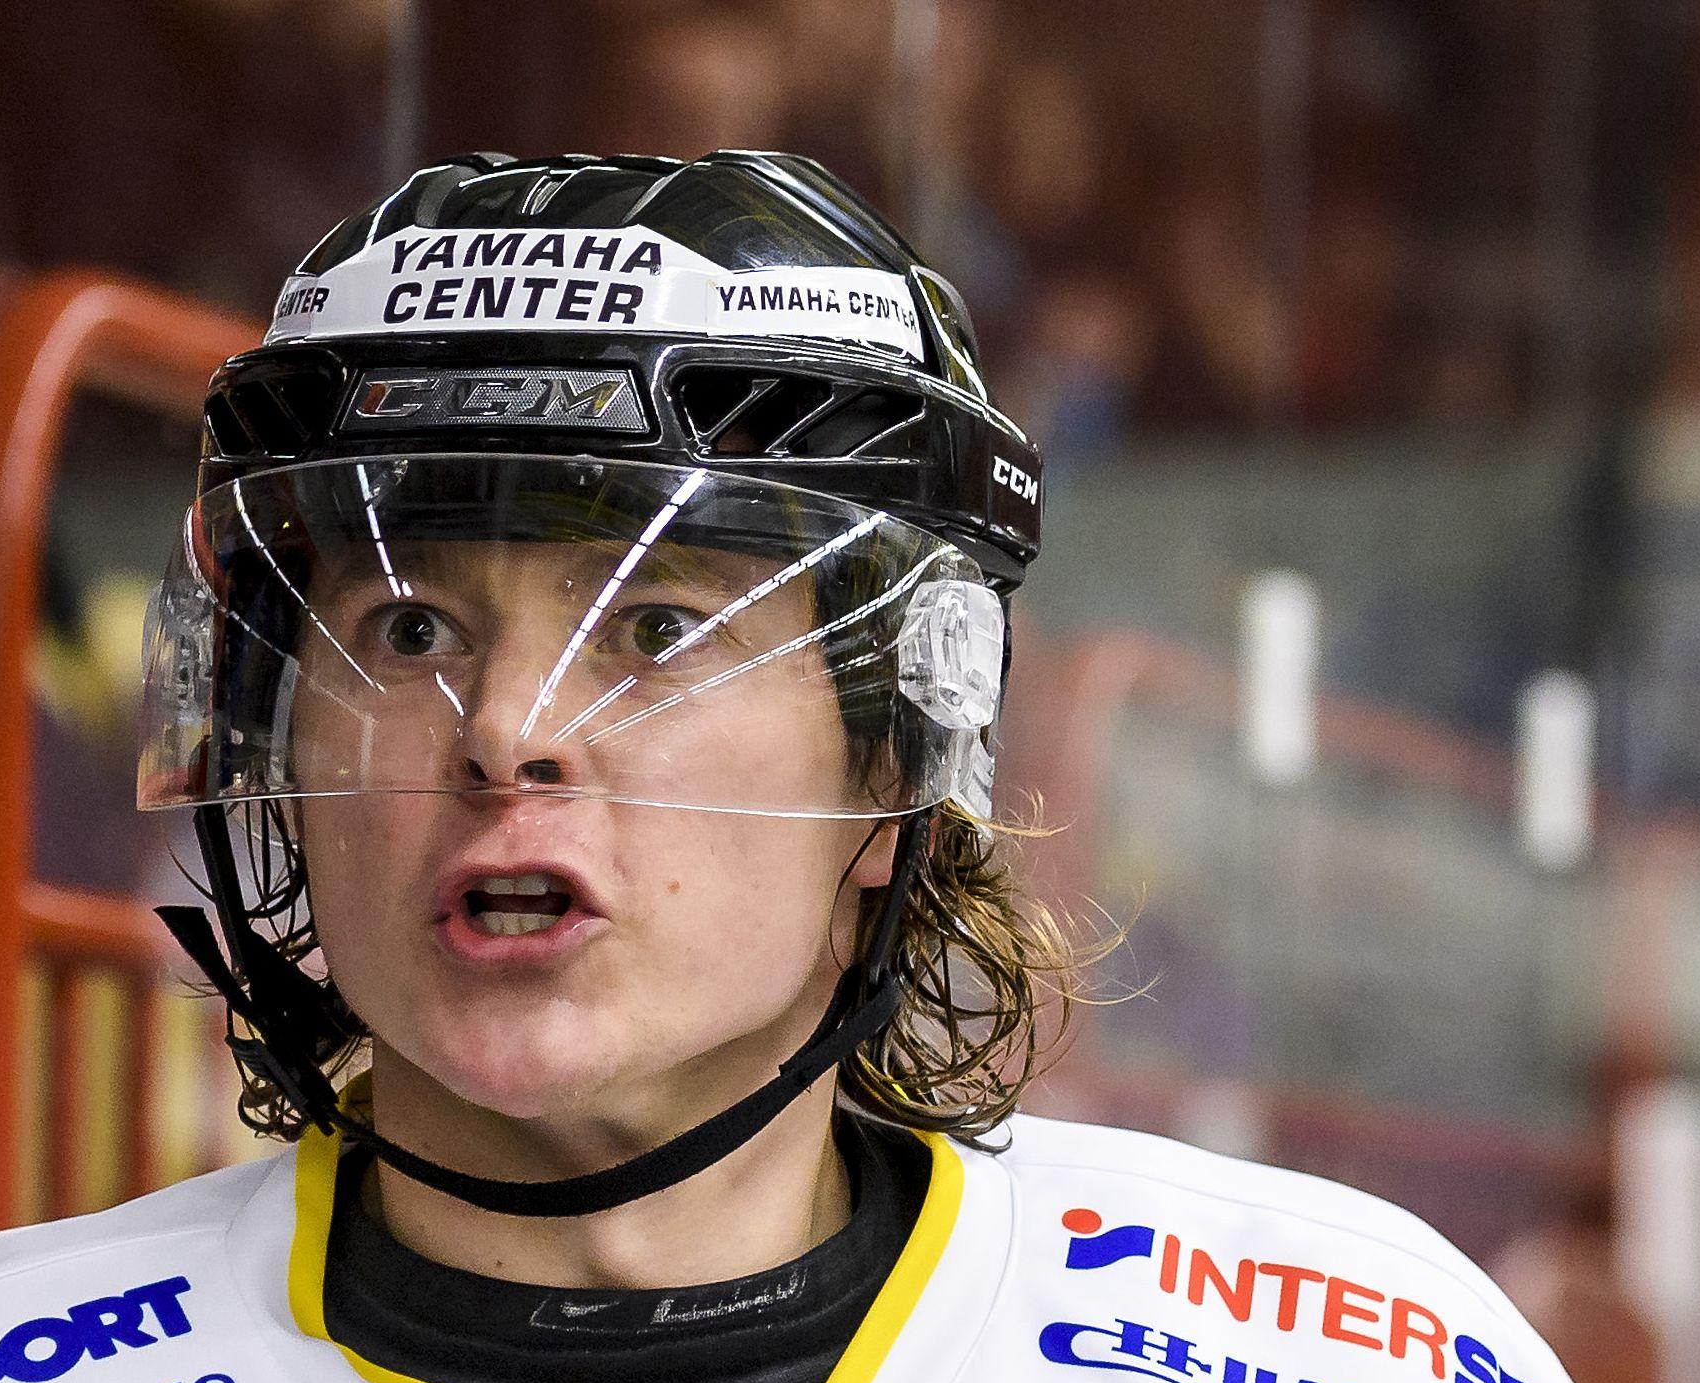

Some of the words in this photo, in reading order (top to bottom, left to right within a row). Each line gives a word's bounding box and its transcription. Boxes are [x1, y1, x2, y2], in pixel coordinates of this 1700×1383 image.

[390, 232, 663, 276] YAMAHA
[277, 286, 330, 317] ENTER
[382, 276, 645, 325] CENTER
[716, 285, 841, 313] YAMAHA
[848, 290, 919, 334] CENTER
[356, 378, 628, 420] CCM
[992, 454, 1039, 506] CCM
